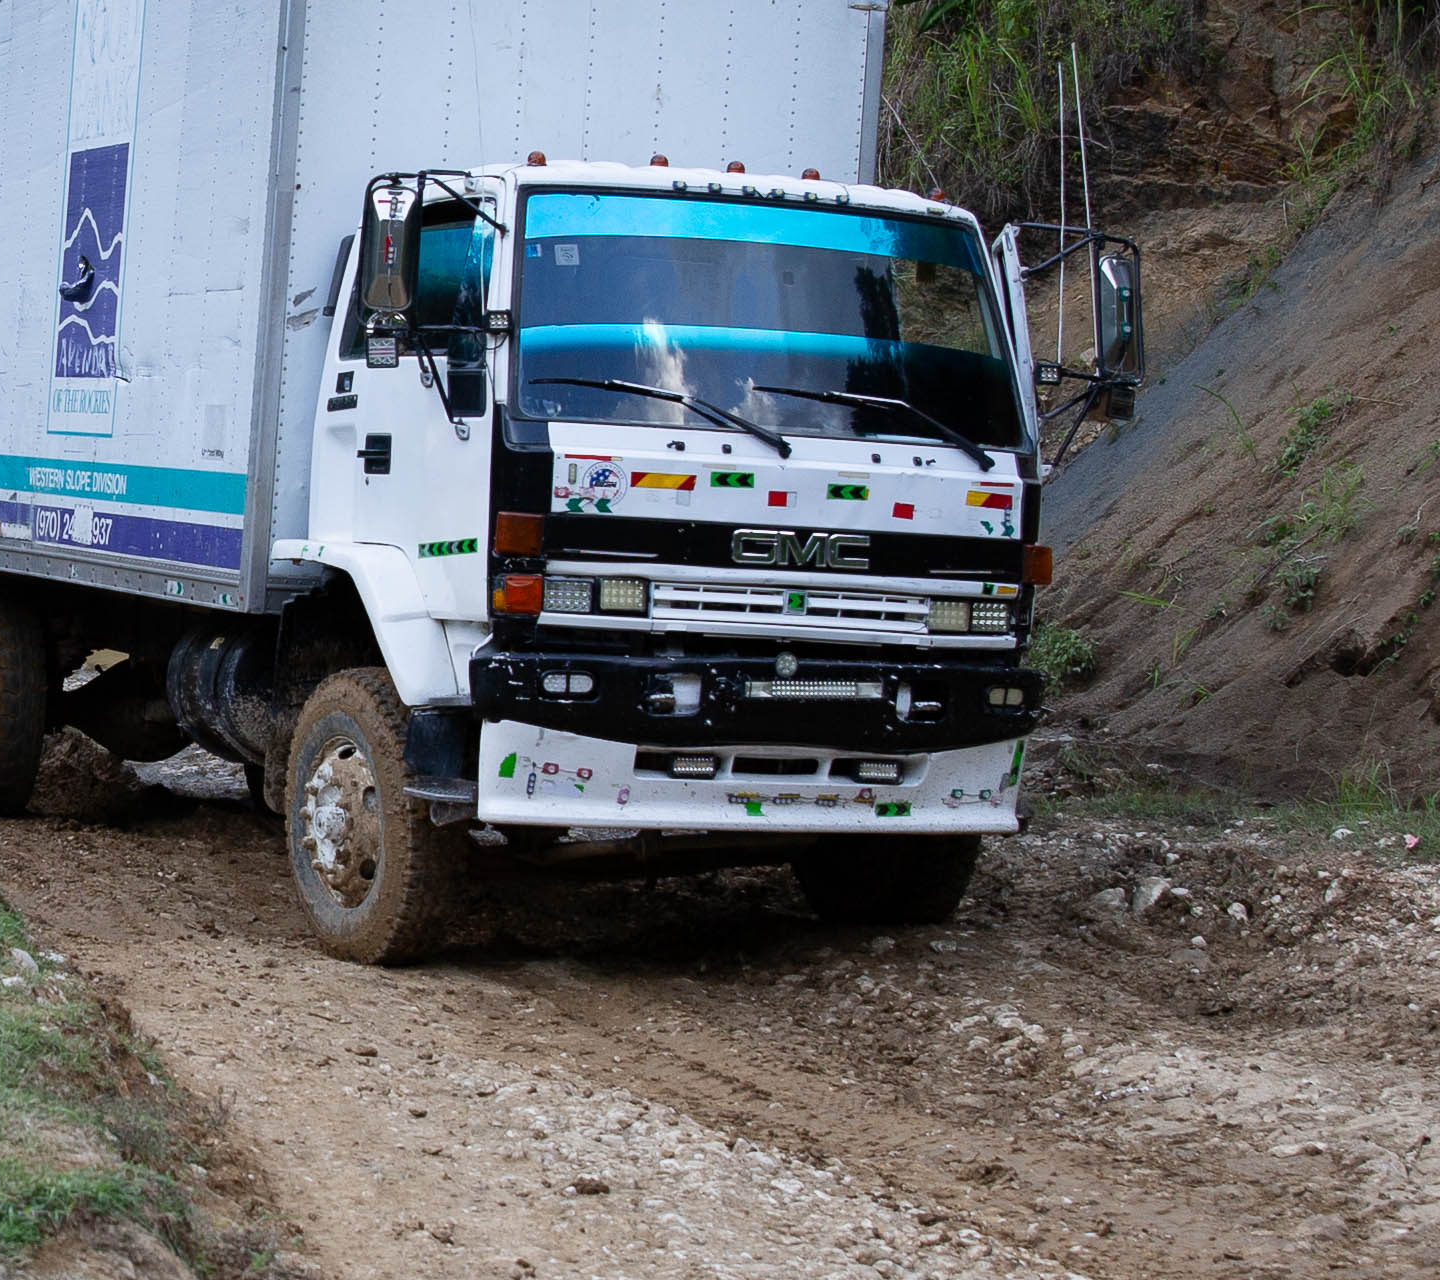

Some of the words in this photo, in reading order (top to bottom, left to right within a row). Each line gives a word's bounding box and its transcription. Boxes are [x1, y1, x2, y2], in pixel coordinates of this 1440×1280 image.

[28, 466, 65, 489] WESTERN
[65, 470, 91, 492] SLOPE
[92, 472, 127, 495] DIVISION
[35, 507, 61, 541] (970)
[731, 528, 870, 570] GMC
